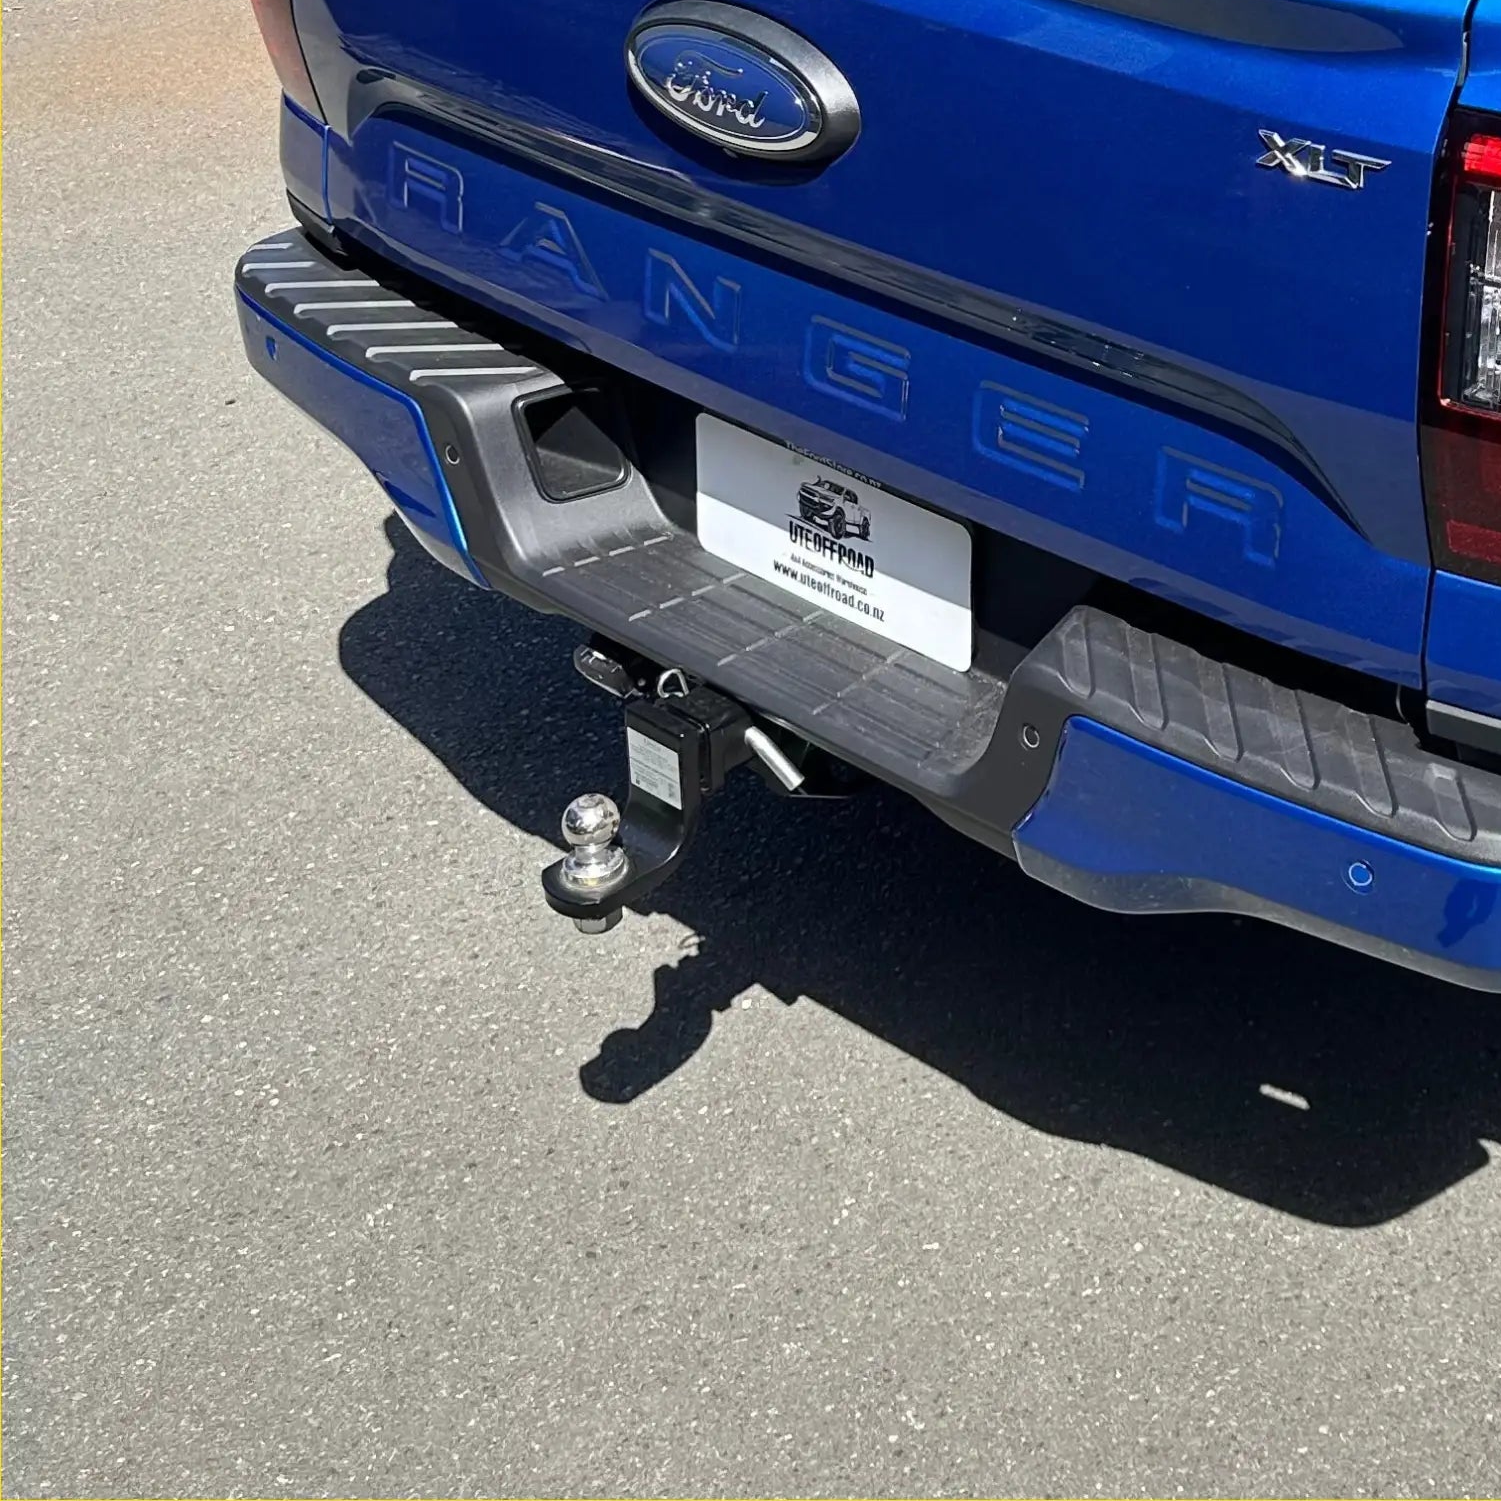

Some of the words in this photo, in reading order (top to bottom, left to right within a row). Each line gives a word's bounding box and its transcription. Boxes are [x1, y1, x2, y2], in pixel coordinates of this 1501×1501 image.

[664, 50, 768, 128] Ford
[1256, 129, 1392, 189] XLT
[386, 141, 1284, 569] RANGER
[789, 520, 875, 578] UTEOFFROAD
[773, 559, 885, 622] www.uteoffroad.co.nz
